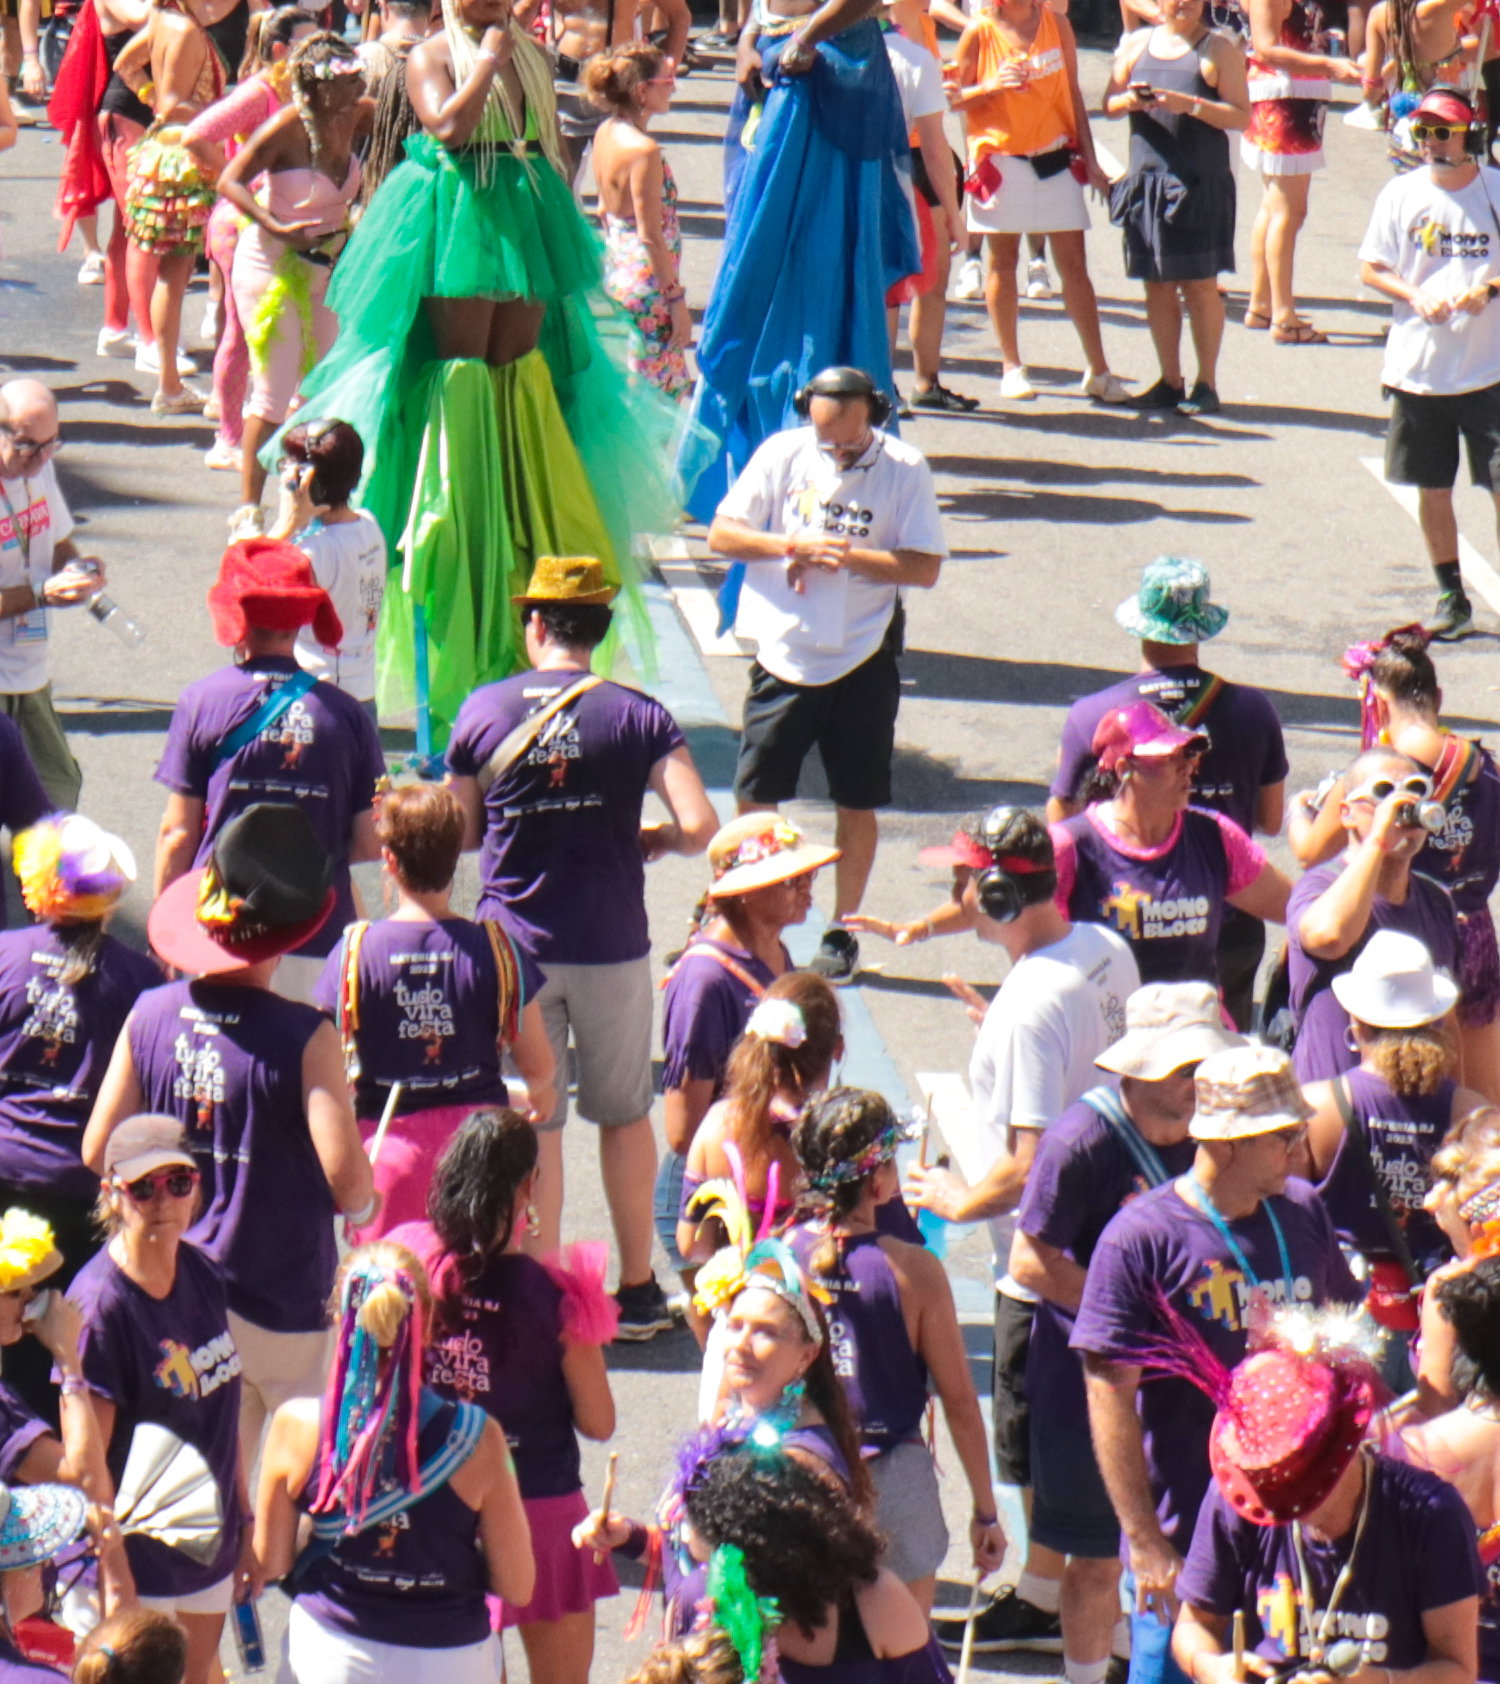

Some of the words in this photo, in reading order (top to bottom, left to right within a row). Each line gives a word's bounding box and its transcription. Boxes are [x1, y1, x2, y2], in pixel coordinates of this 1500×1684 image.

[1440, 232, 1490, 246] MONO
[1142, 896, 1208, 922] MONO
[1142, 917, 1208, 938] BLOCO
[394, 977, 443, 1008] tudo
[403, 1000, 452, 1022] vira
[397, 1018, 454, 1038] festa
[182, 1058, 225, 1085] vira
[173, 1079, 225, 1102] festa
[1371, 1147, 1418, 1178] tudo
